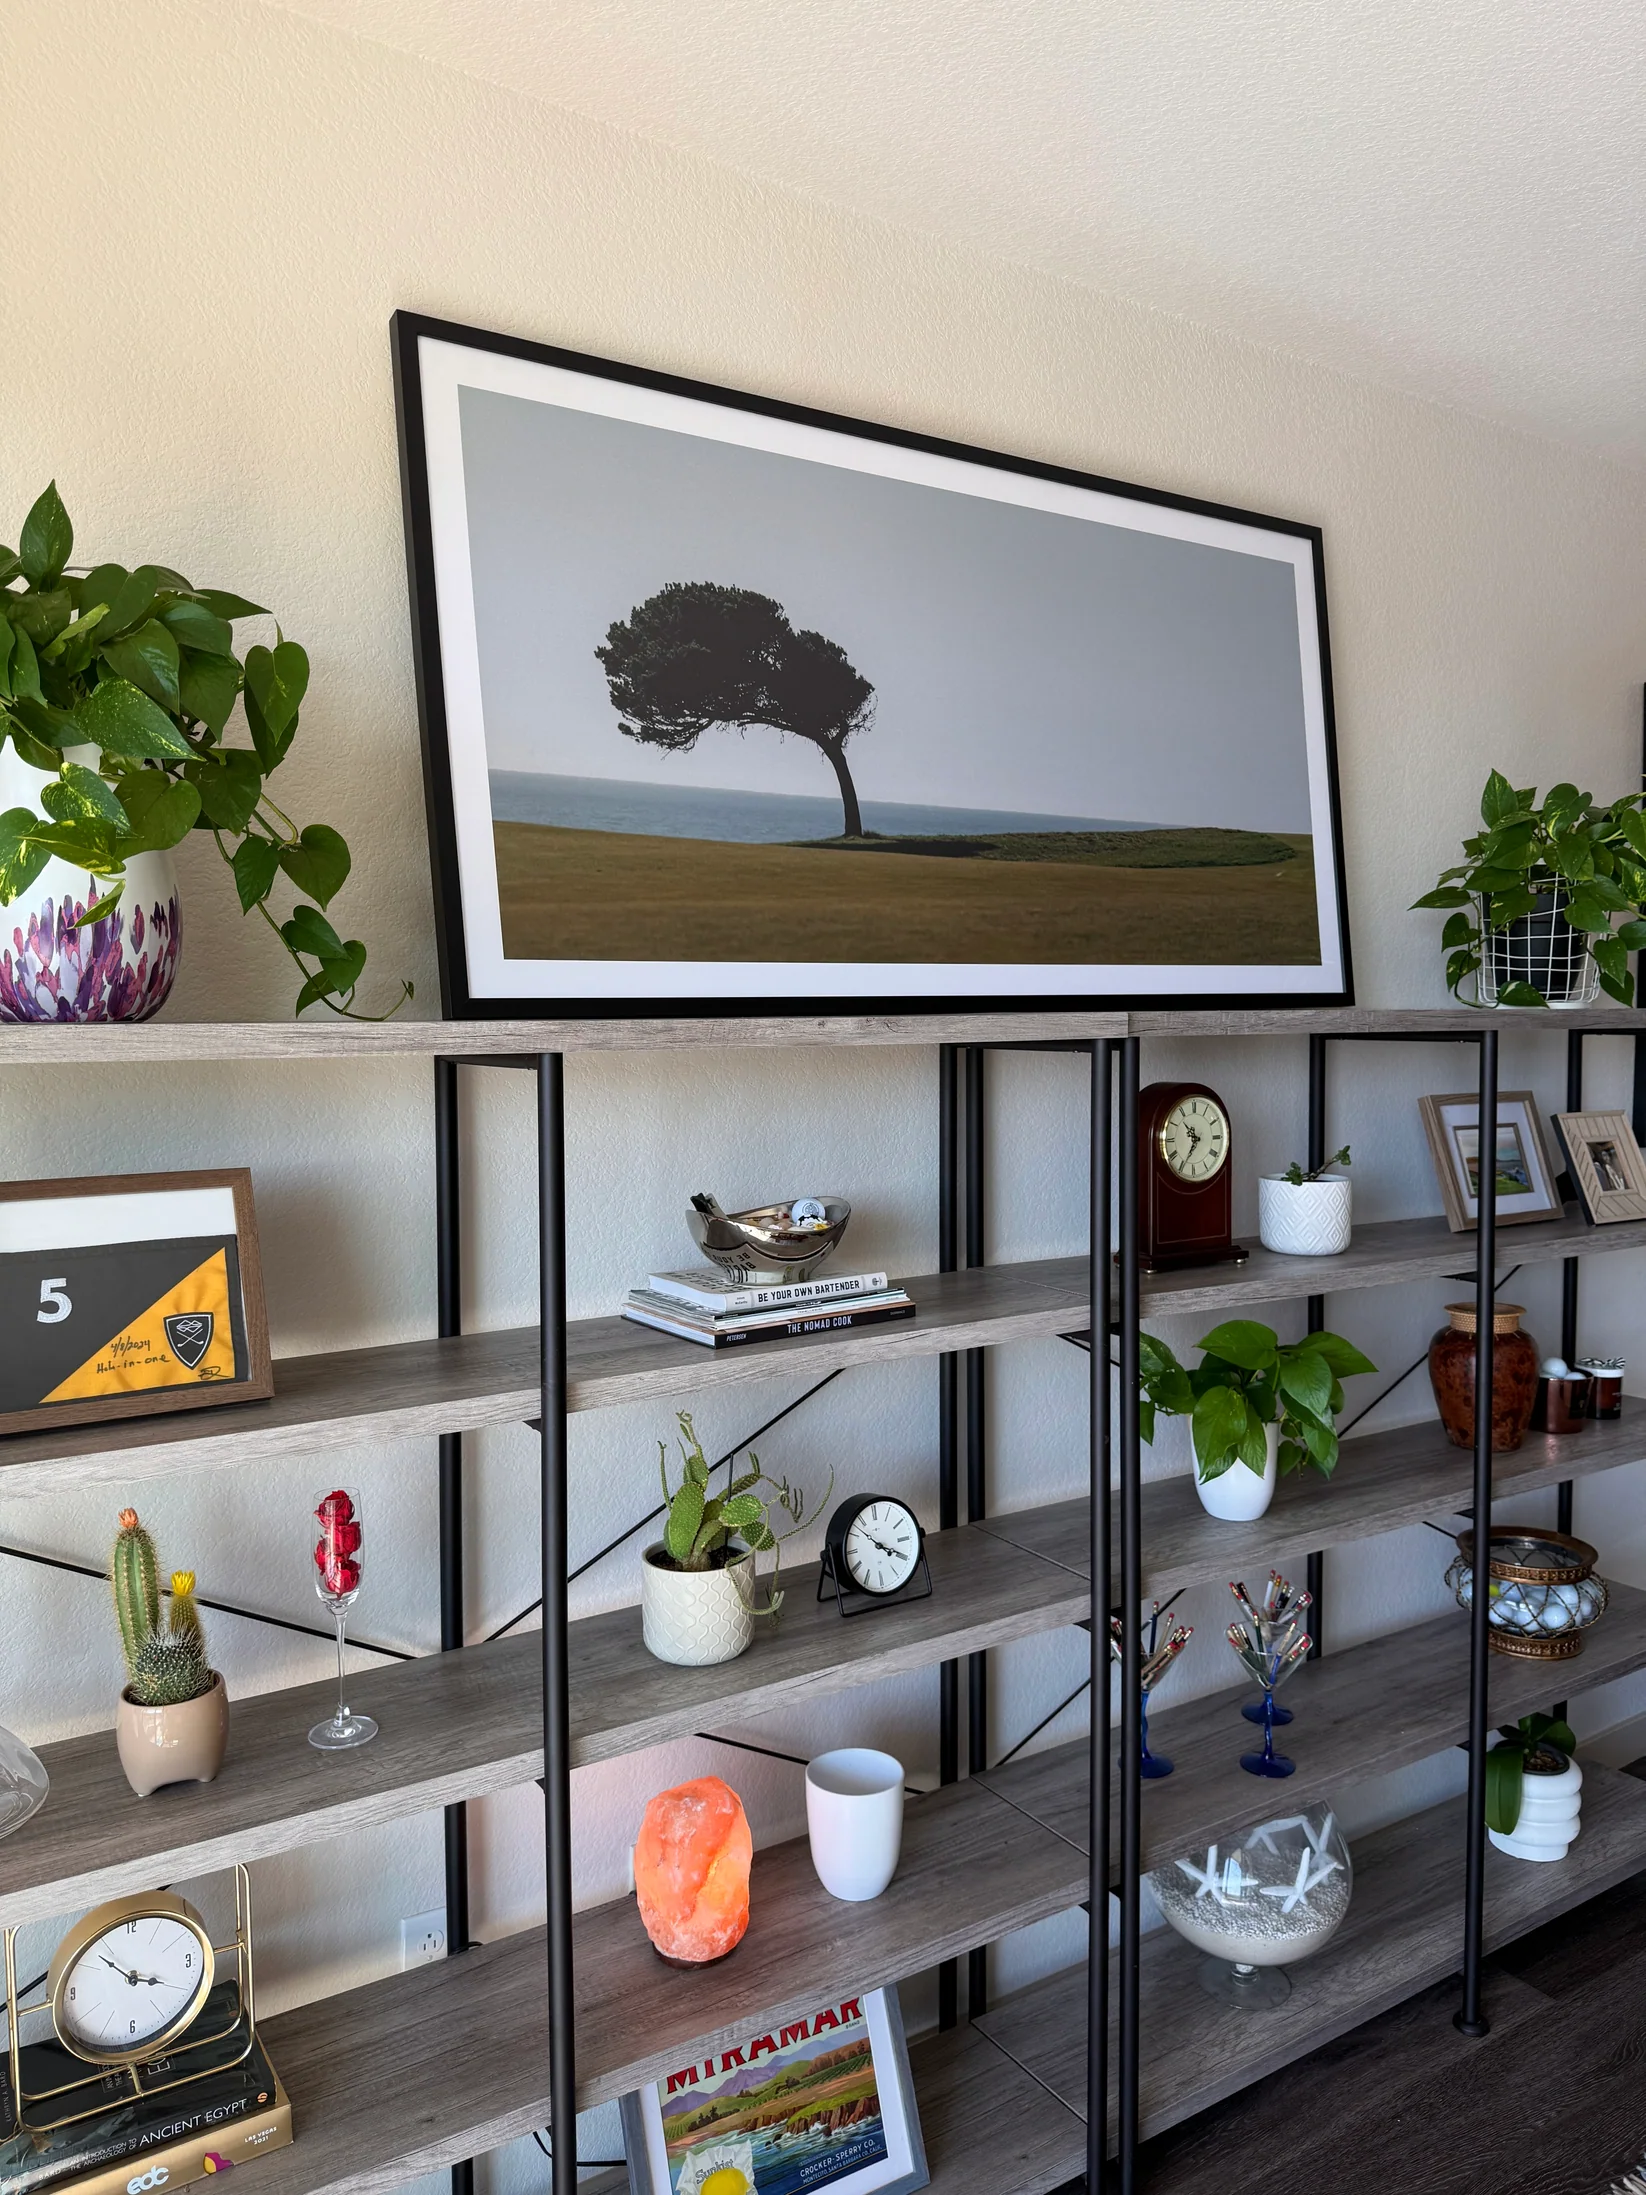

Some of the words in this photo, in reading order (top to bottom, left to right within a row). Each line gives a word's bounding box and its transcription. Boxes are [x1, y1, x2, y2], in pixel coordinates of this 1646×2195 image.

[758, 1292, 768, 1302] BE
[770, 1290, 792, 1300] YOUR
[794, 1287, 813, 1296] OWN
[815, 1280, 860, 1296] BARTENDER
[36, 1277, 72, 1324] 5
[726, 1332, 747, 1342] PETERSEN
[787, 1323, 802, 1334] THE
[804, 1318, 830, 1332] NOMAD
[832, 1315, 852, 1327] COOK
[126, 1921, 136, 1934] 12
[186, 1954, 192, 1968] 3
[70, 1987, 76, 2000] 9
[129, 2020, 136, 2034] 6
[139, 2114, 202, 2148] ANCIENT
[205, 2098, 248, 2122] EGYPT
[244, 2134, 256, 2143] LAS
[258, 2126, 277, 2138] VEGAS
[864, 2139, 876, 2149] CO.
[70, 2158, 80, 2166] AN
[82, 2142, 127, 2160] INTRODUCTION
[70, 2162, 82, 2171] THE
[84, 2148, 127, 2166] ARCHAEOLOGY
[38, 2168, 61, 2180] BARD
[828, 2163, 842, 2173] SANTA
[126, 2165, 170, 2195] edc
